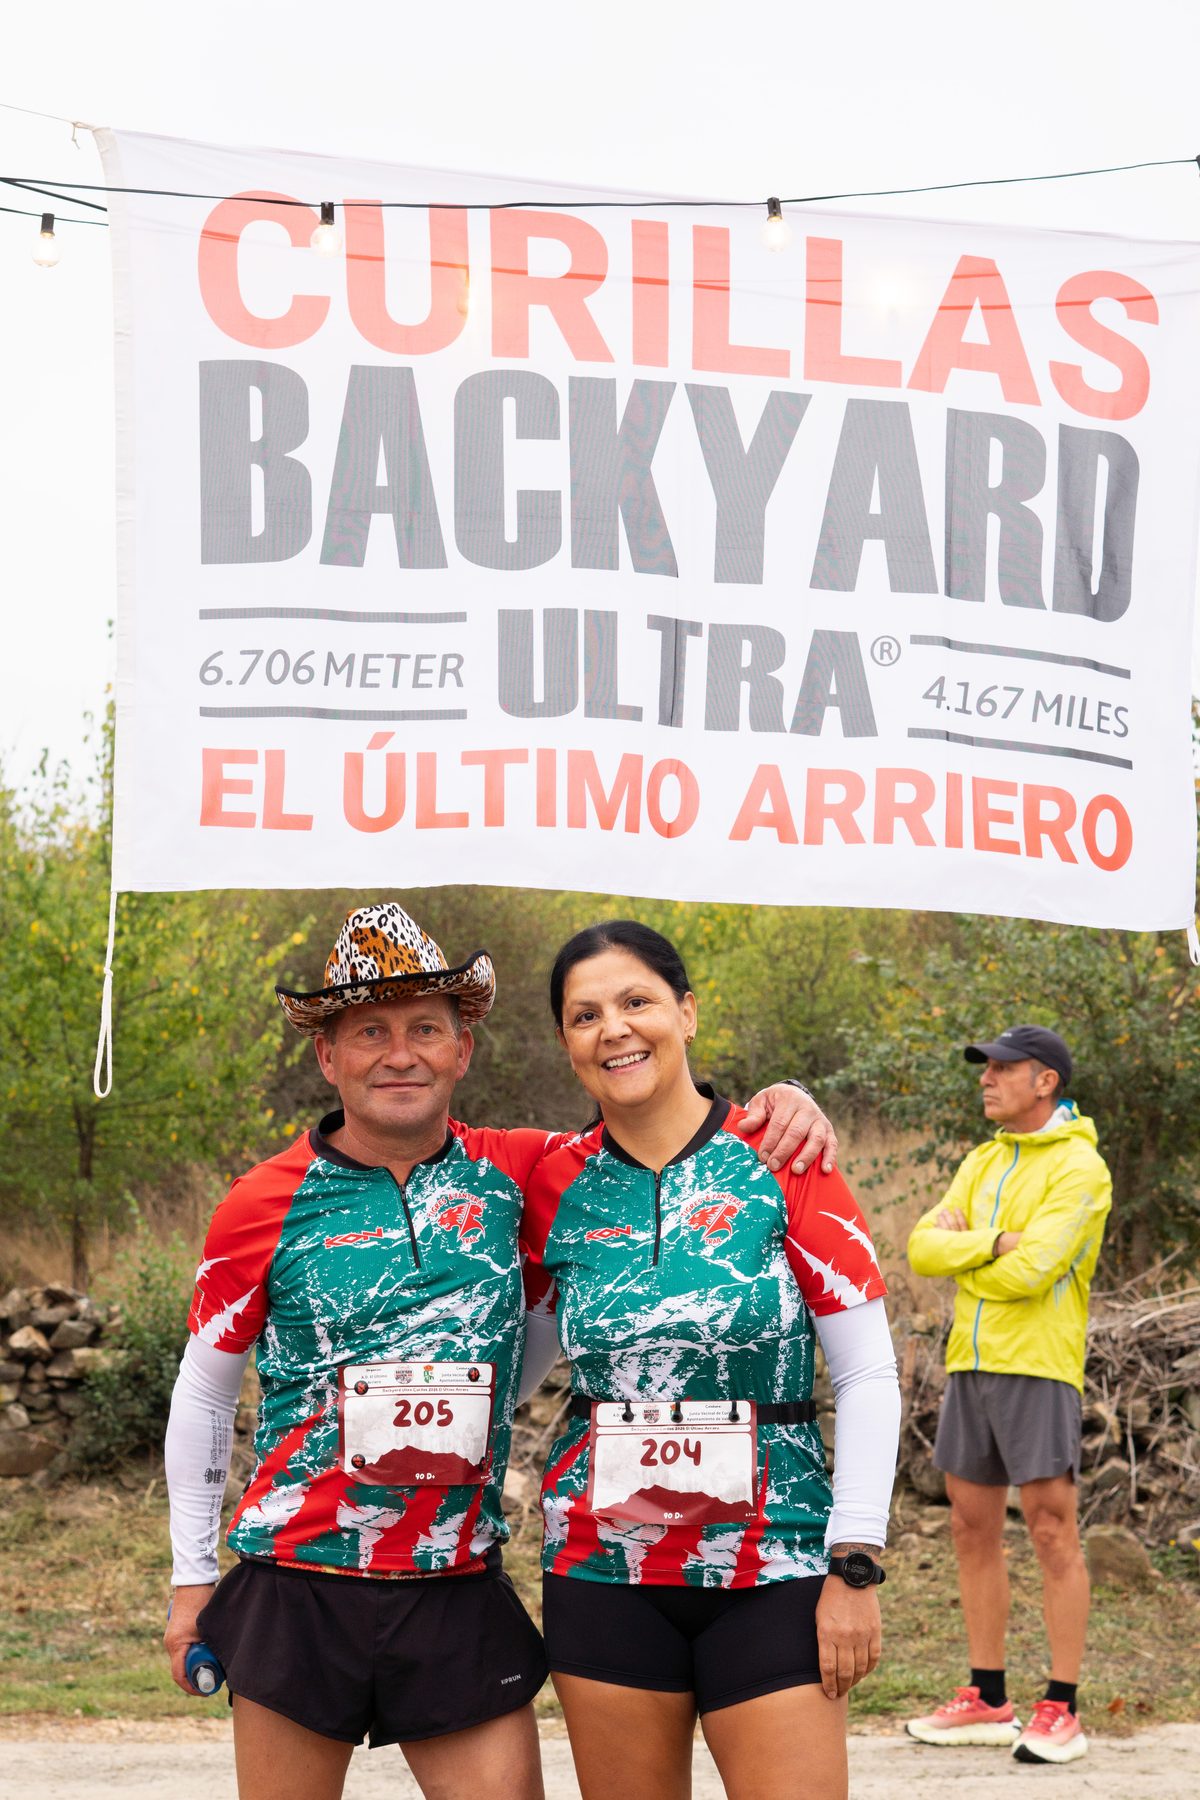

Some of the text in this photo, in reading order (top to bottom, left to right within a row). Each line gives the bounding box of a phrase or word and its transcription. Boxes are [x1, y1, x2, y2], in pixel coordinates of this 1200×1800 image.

[198, 190, 1160, 421] CURILLAS
[198, 359, 1140, 624] BACKYARD
[199, 648, 464, 689] 6.706 METER
[922, 675, 1130, 738] 4.167 MILES
[199, 731, 1134, 872] EL ÚLTIMO ARRIERO
[680, 1199, 703, 1217] TIGRES
[392, 1399, 454, 1428] 205
[639, 1437, 702, 1467] 204
[415, 1472, 436, 1480] 90 D+
[663, 1512, 673, 1520] 90
